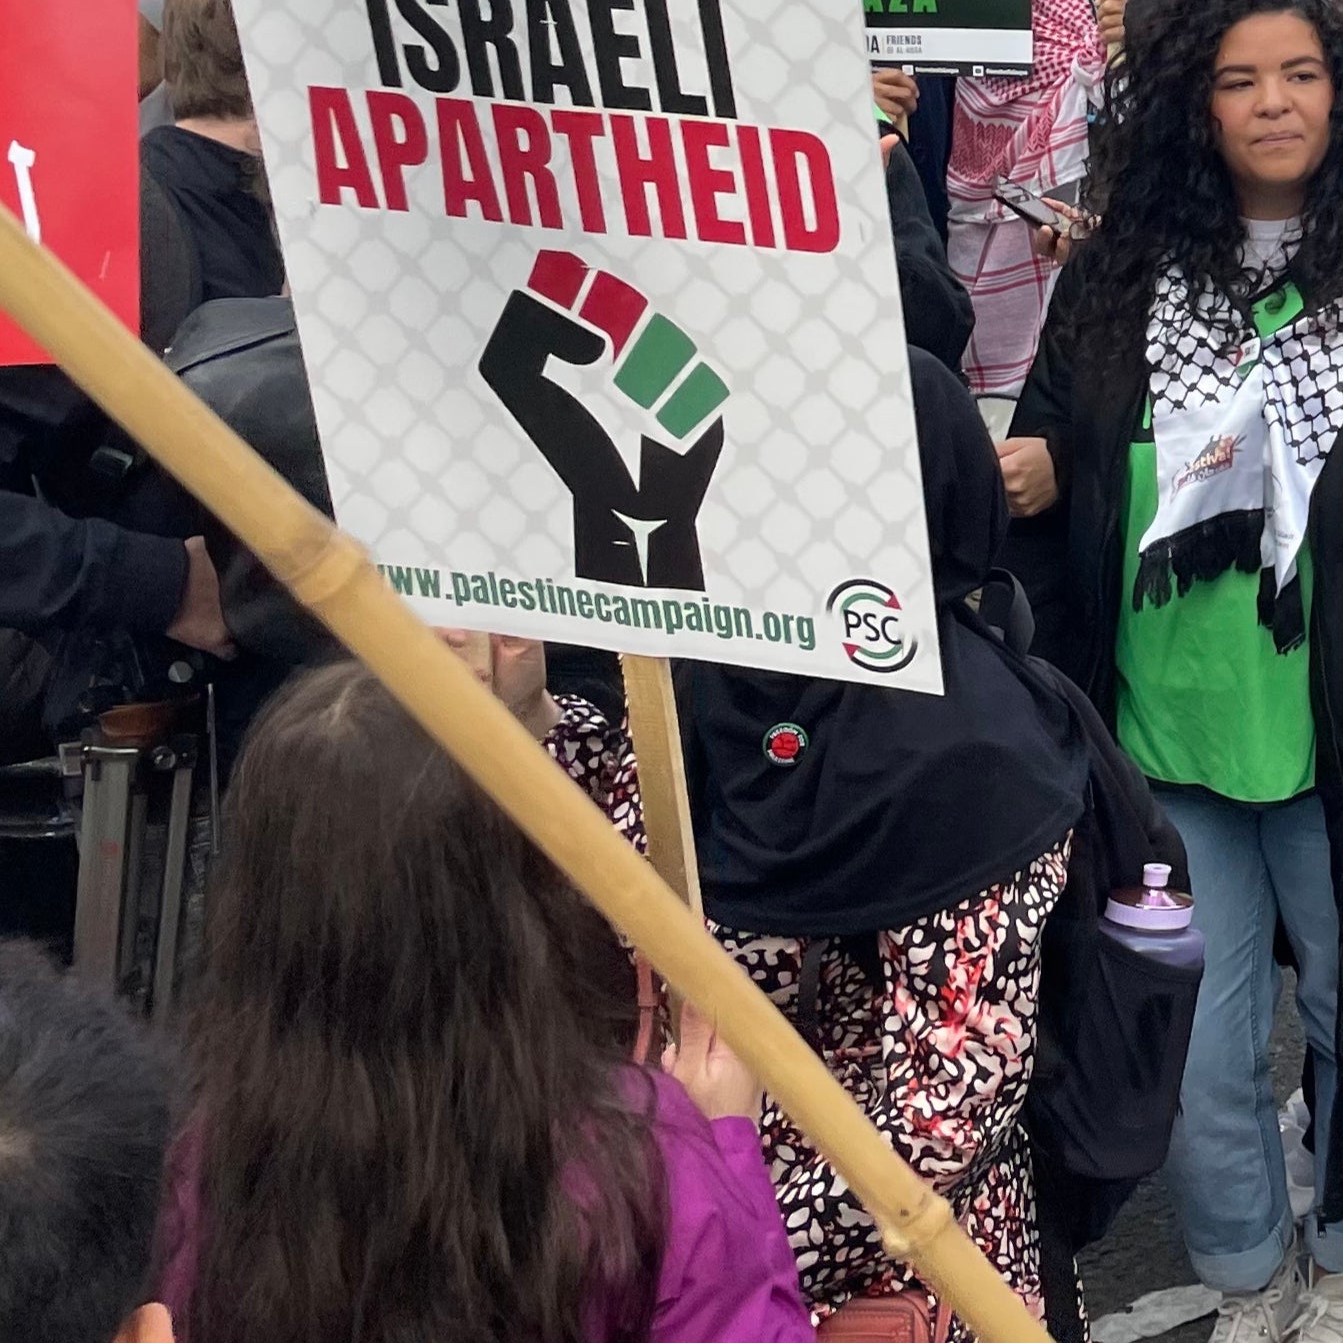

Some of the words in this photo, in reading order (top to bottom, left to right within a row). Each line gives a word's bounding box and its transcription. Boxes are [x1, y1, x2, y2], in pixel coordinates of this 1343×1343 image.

[307, 86, 842, 254] APARTHEID
[377, 564, 816, 651] ww.palestinecampaign.org
[843, 611, 901, 646] PSC
